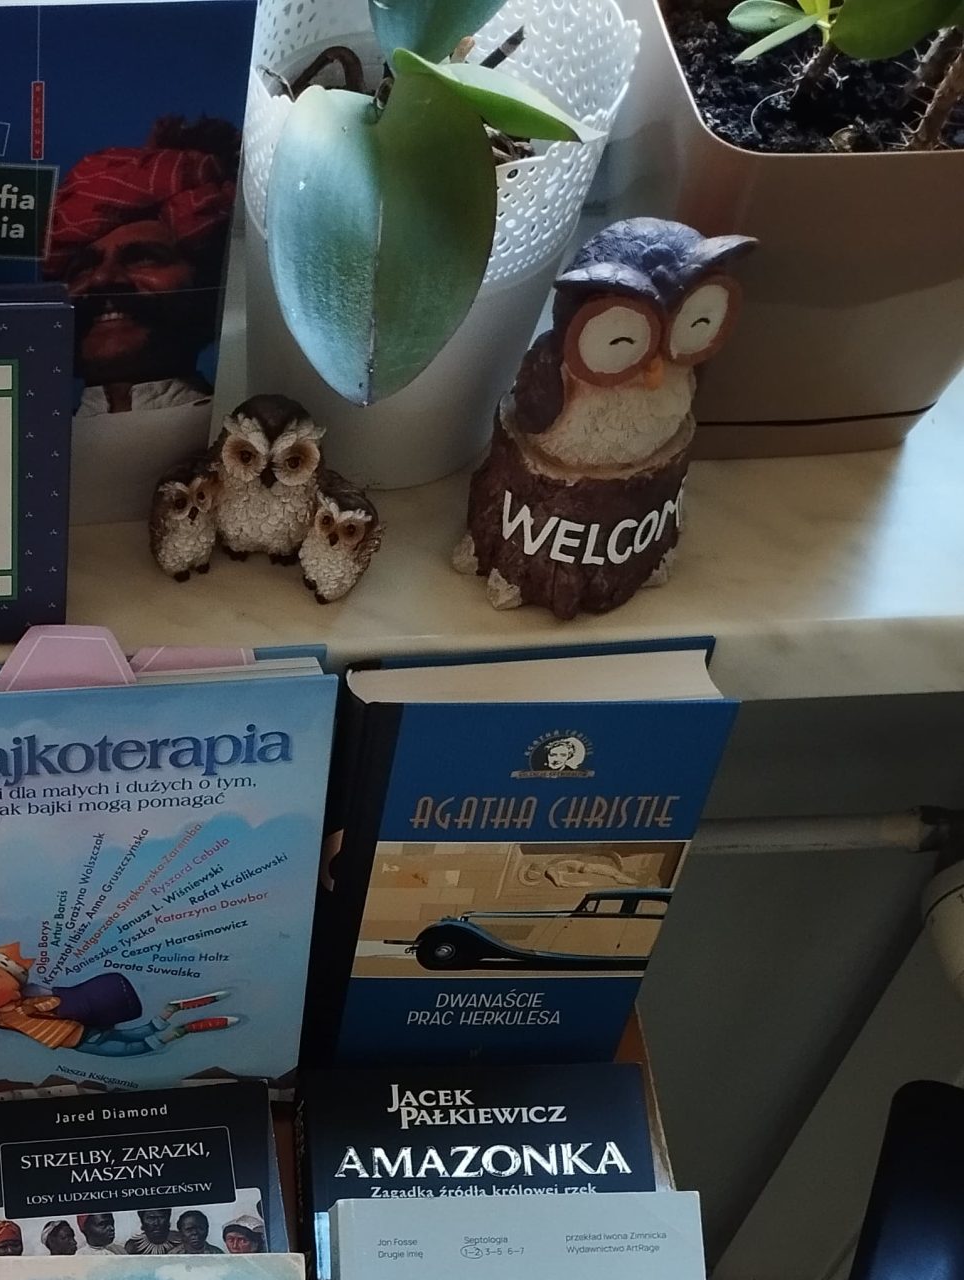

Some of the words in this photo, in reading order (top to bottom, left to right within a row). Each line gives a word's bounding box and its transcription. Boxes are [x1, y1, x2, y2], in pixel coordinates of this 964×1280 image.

[9, 784, 36, 799] dla
[42, 780, 108, 799] małych
[116, 781, 120, 793] i
[127, 777, 193, 796] dużych
[199, 778, 210, 788] o
[217, 775, 257, 791] tym,
[28, 798, 72, 816] bajki
[79, 797, 131, 813] mogą
[137, 792, 225, 813] pomagać
[410, 796, 537, 830] AGATHA
[549, 795, 679, 829] CHRISTIE
[153, 953, 194, 962] Paulina
[199, 953, 229, 961] Holtz
[104, 959, 143, 973] Dorota
[146, 965, 200, 978] Suwalska
[437, 989, 544, 1008] DWANAŚCIE
[407, 1011, 452, 1025] PRAC
[460, 1010, 560, 1025] HERKULESA
[55, 1111, 94, 1124] Jared
[102, 1105, 168, 1119] Diamond
[21, 1150, 116, 1170] STRZELBY,
[122, 1142, 209, 1161] ZARAZKI,
[335, 1141, 632, 1179] AMAZONKA
[70, 1164, 164, 1183] MASZYNY
[26, 1195, 55, 1205] LOSY
[58, 1189, 117, 1203] LUDZKICH
[122, 1182, 212, 1198] SPOŁECZEŃSTW
[394, 1238, 418, 1246] Fosse
[464, 1236, 508, 1246] Septologia
